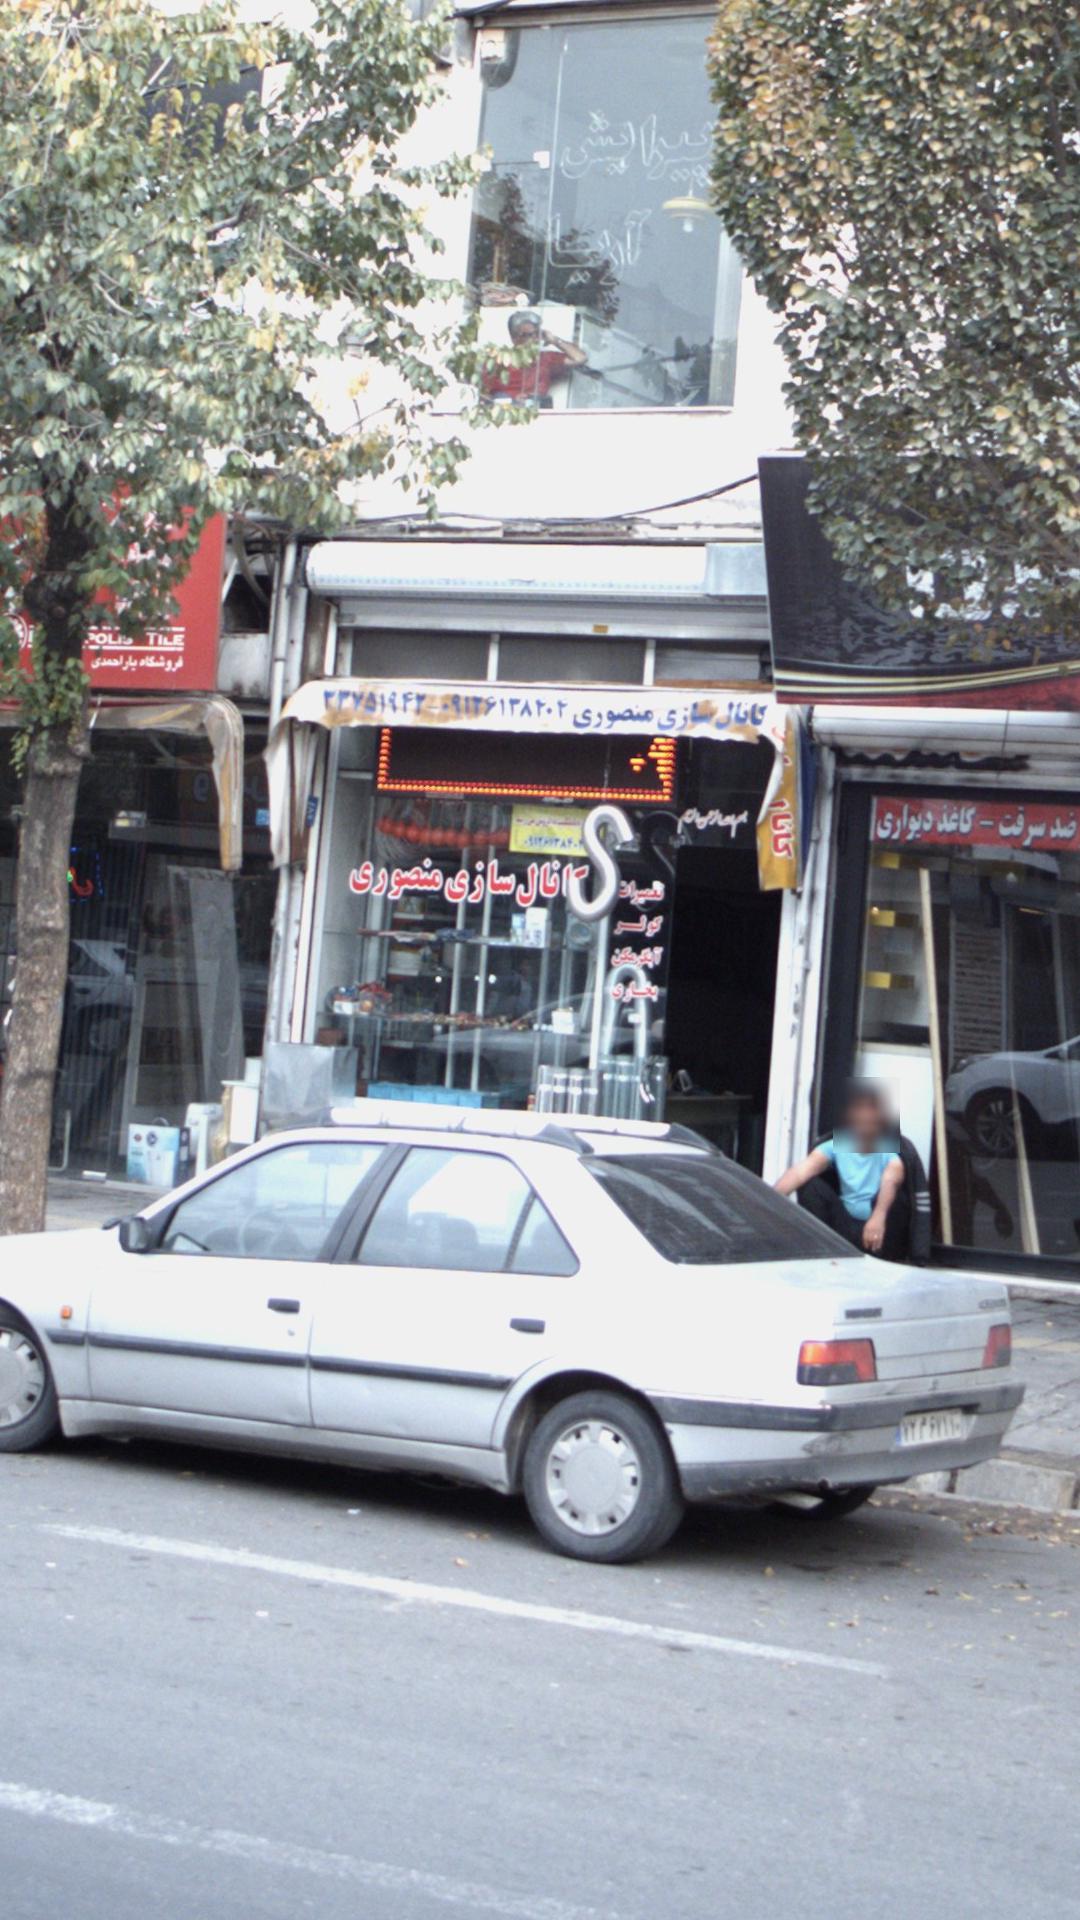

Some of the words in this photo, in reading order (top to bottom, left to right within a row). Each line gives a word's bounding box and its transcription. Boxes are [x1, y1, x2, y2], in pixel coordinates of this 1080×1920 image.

[139, 654, 185, 673] فروشگاه
[573, 703, 653, 730] منصوری
[715, 700, 769, 730] کانال
[876, 803, 933, 841] دیواری
[937, 803, 976, 835] کاغذ
[999, 805, 1047, 847] سرقت
[1049, 810, 1077, 839] ضد
[349, 857, 444, 900] منصوری
[445, 858, 517, 904] سازی
[617, 879, 666, 905] تعمیرات
[611, 980, 659, 1004] بخاری
